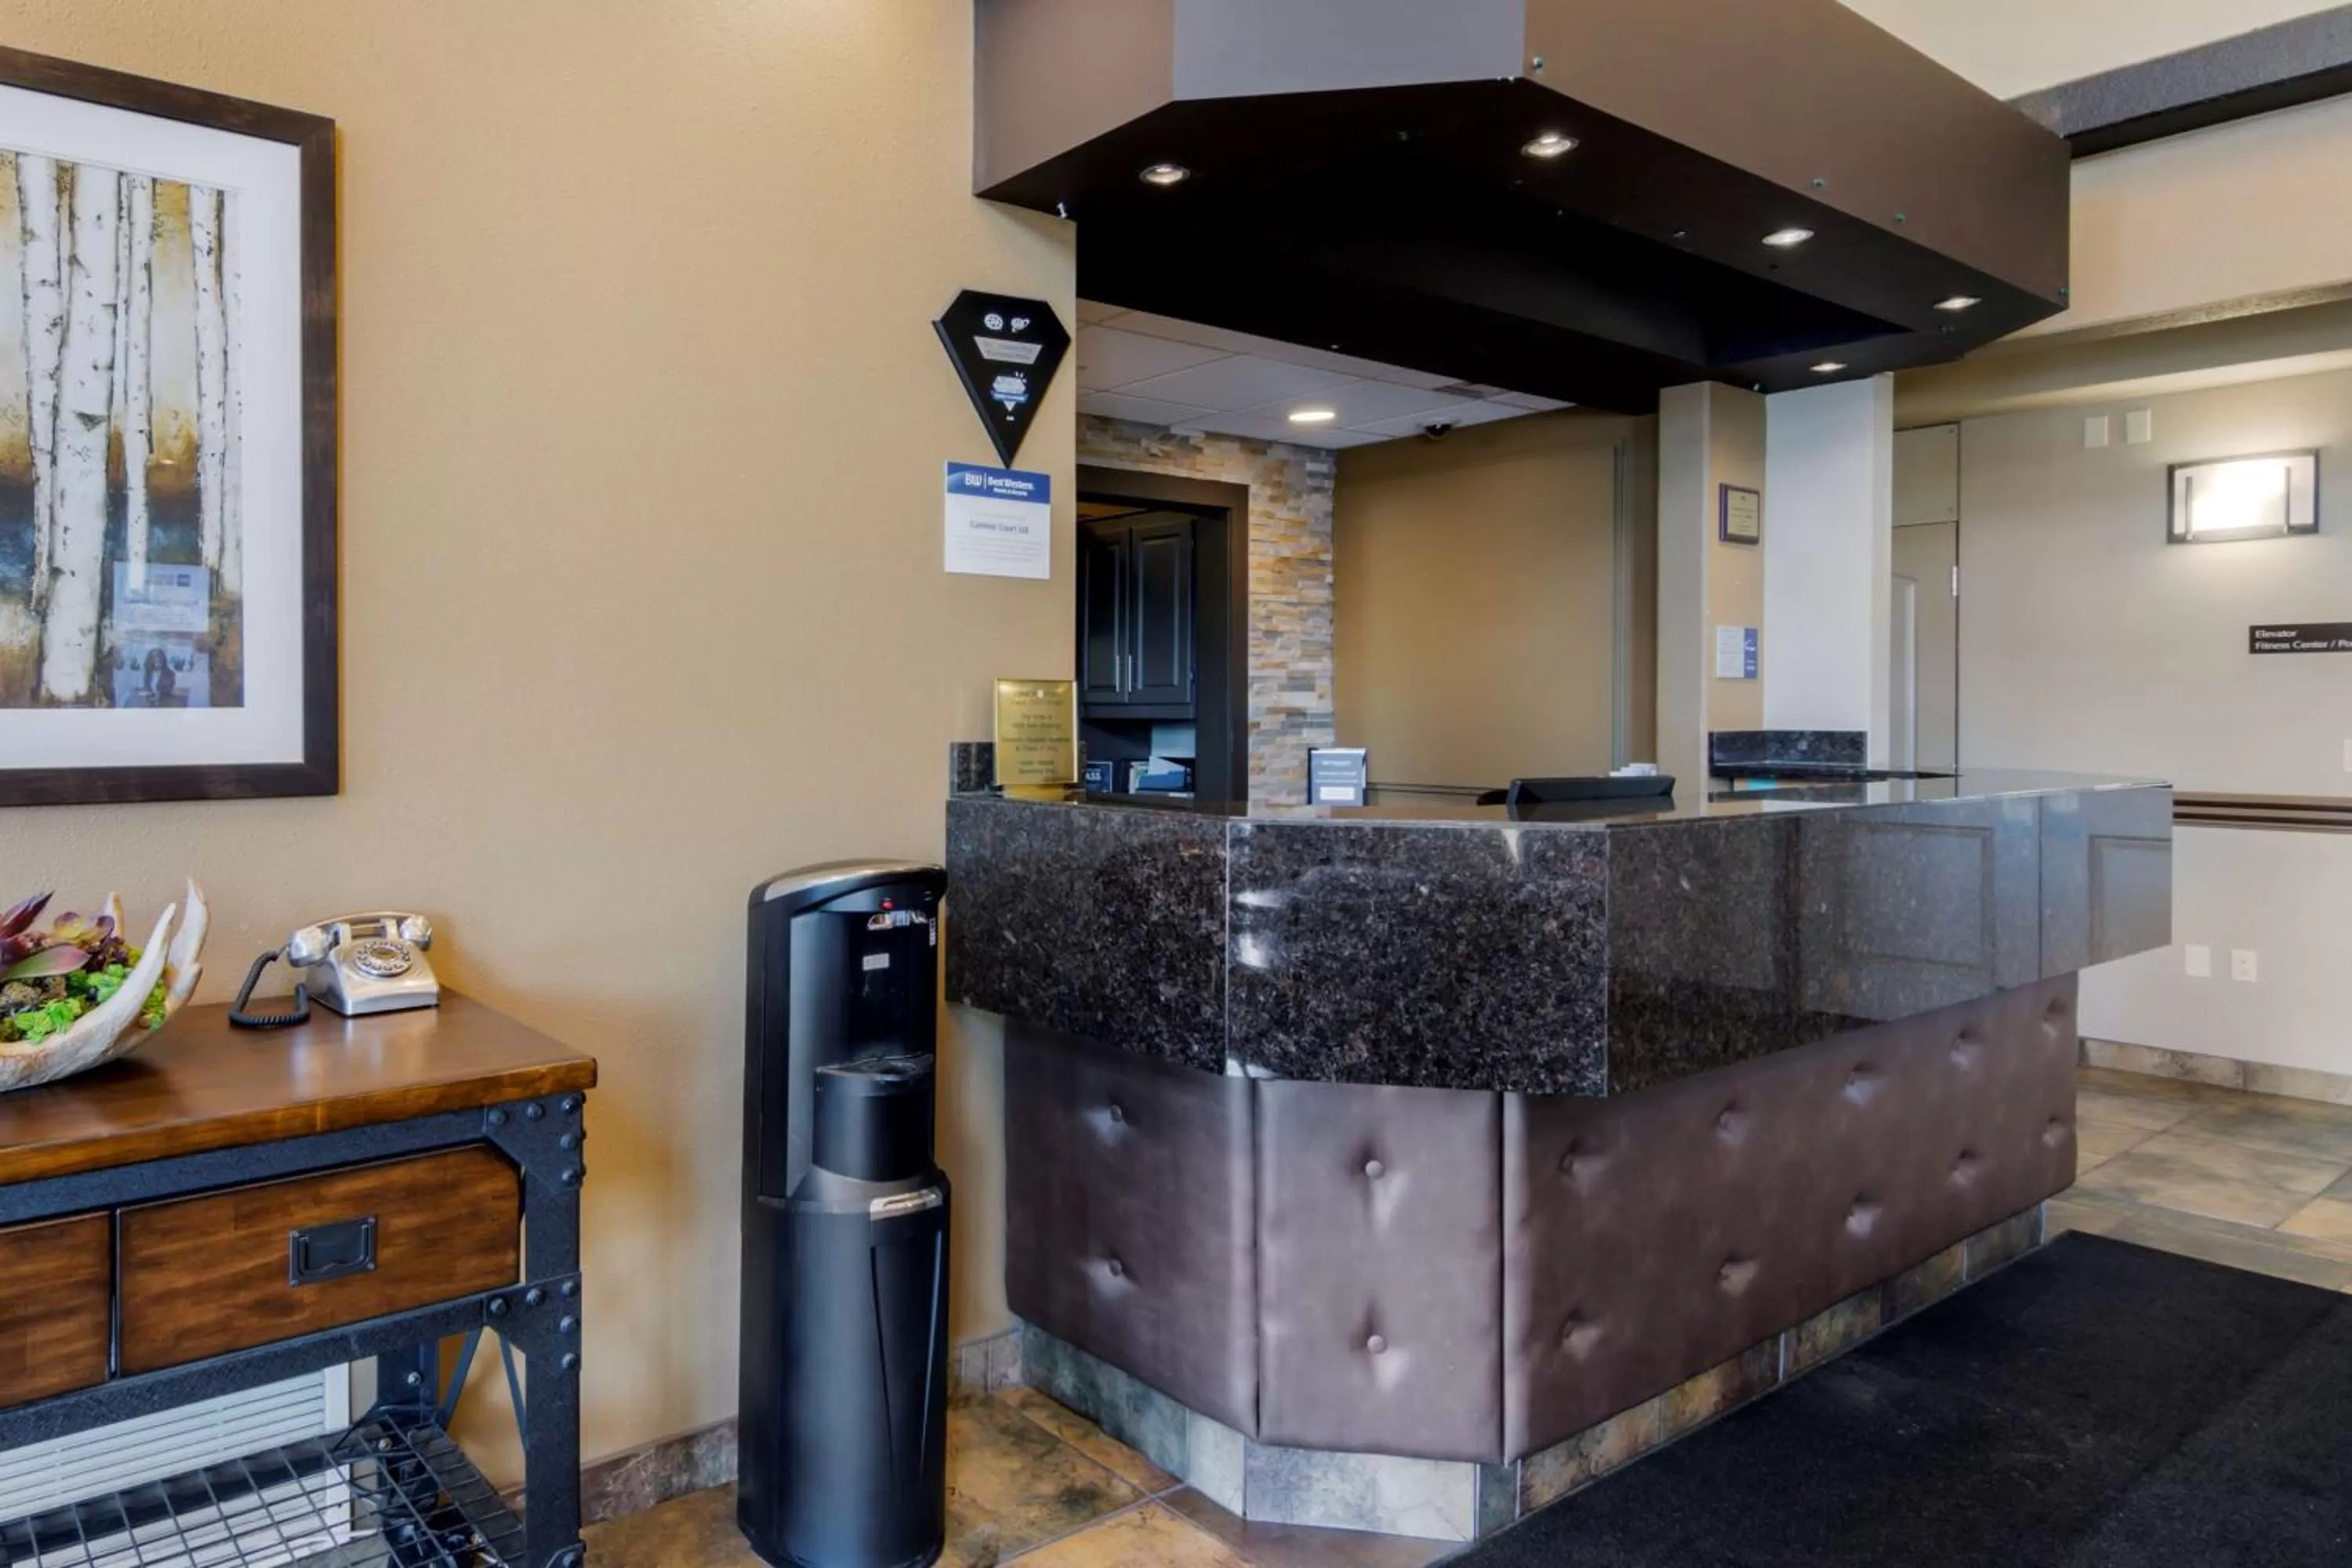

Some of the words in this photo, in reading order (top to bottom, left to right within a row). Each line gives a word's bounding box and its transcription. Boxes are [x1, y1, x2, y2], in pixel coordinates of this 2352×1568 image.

[2256, 630, 2298, 638] Elevator
[2256, 641, 2290, 650] Fitness
[2292, 640, 2328, 649] Center
